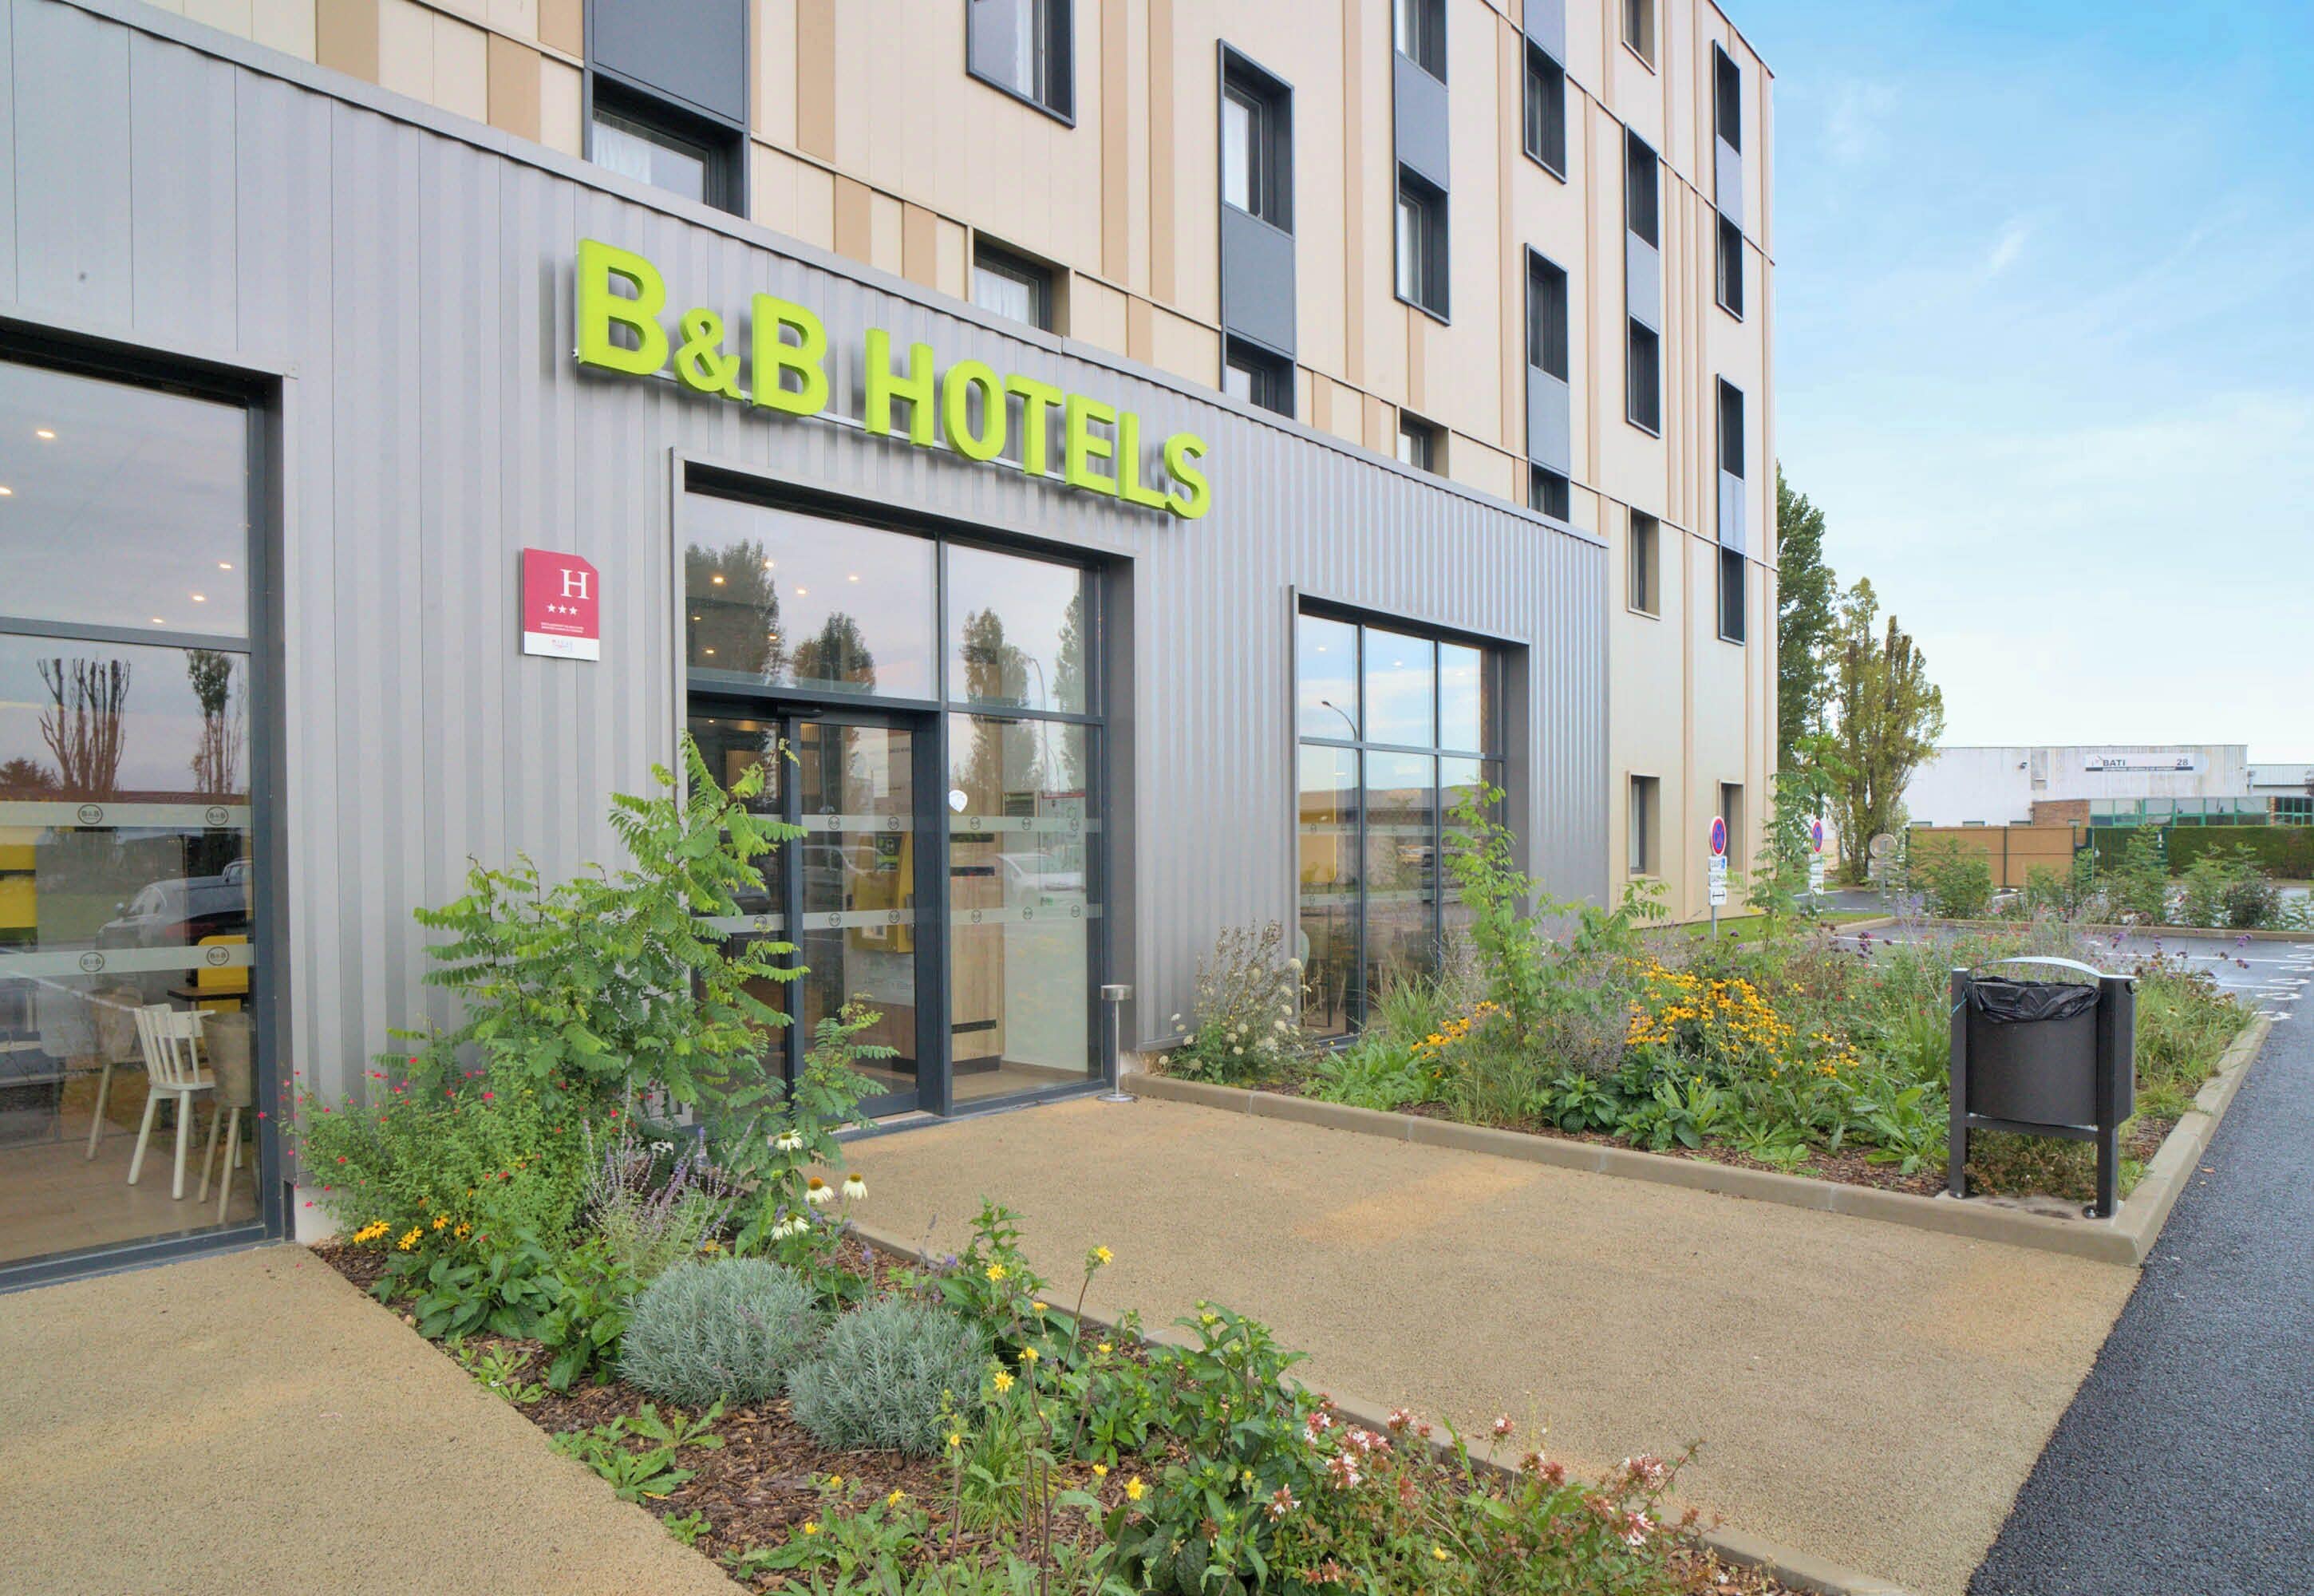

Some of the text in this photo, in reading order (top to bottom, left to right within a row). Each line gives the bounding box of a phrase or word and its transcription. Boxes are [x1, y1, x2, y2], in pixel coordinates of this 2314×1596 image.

[577, 239, 1210, 519] B&B HOTELS
[560, 569, 590, 599] H
